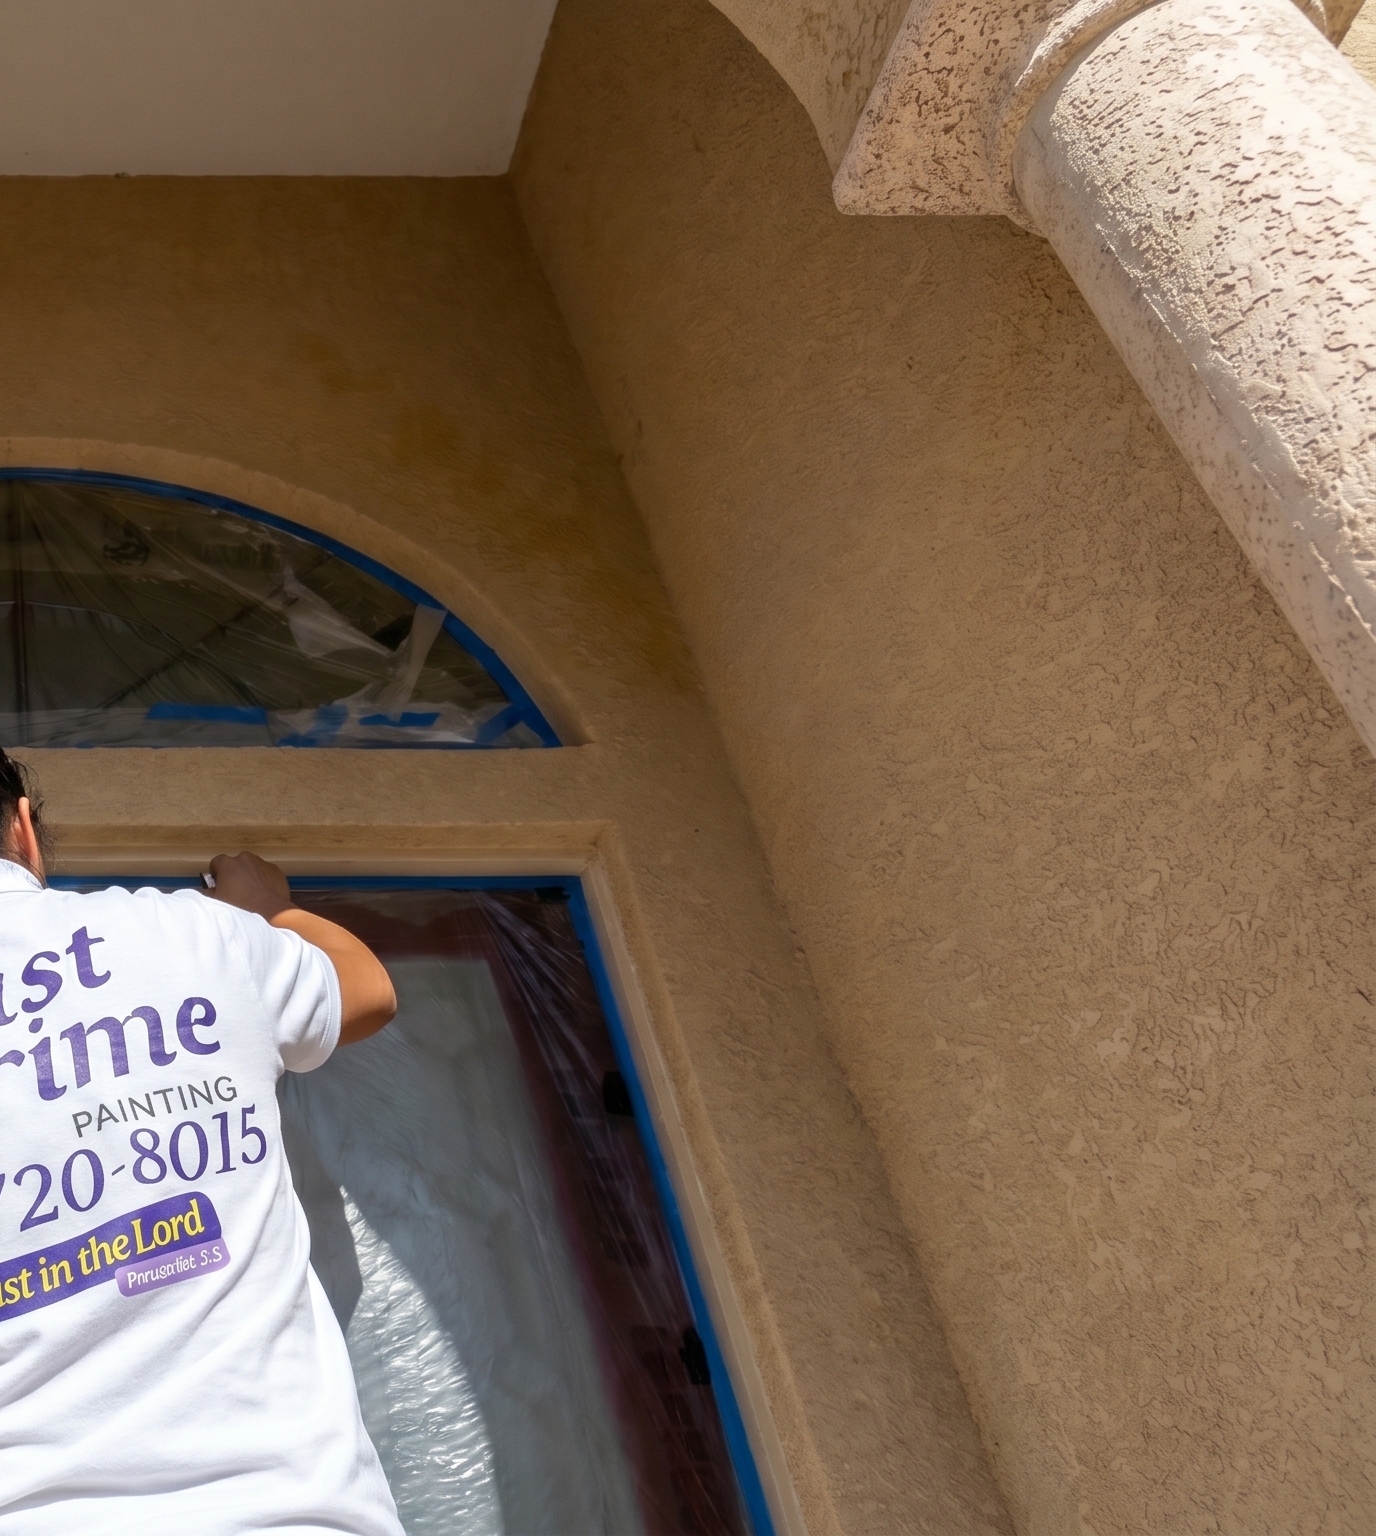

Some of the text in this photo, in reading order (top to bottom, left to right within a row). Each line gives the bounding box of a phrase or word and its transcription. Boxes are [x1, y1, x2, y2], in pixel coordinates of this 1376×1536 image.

[72, 1075, 238, 1139] PAINTING
[38, 1257, 74, 1292] in
[77, 1233, 132, 1277] the
[131, 1198, 205, 1255] Lord
